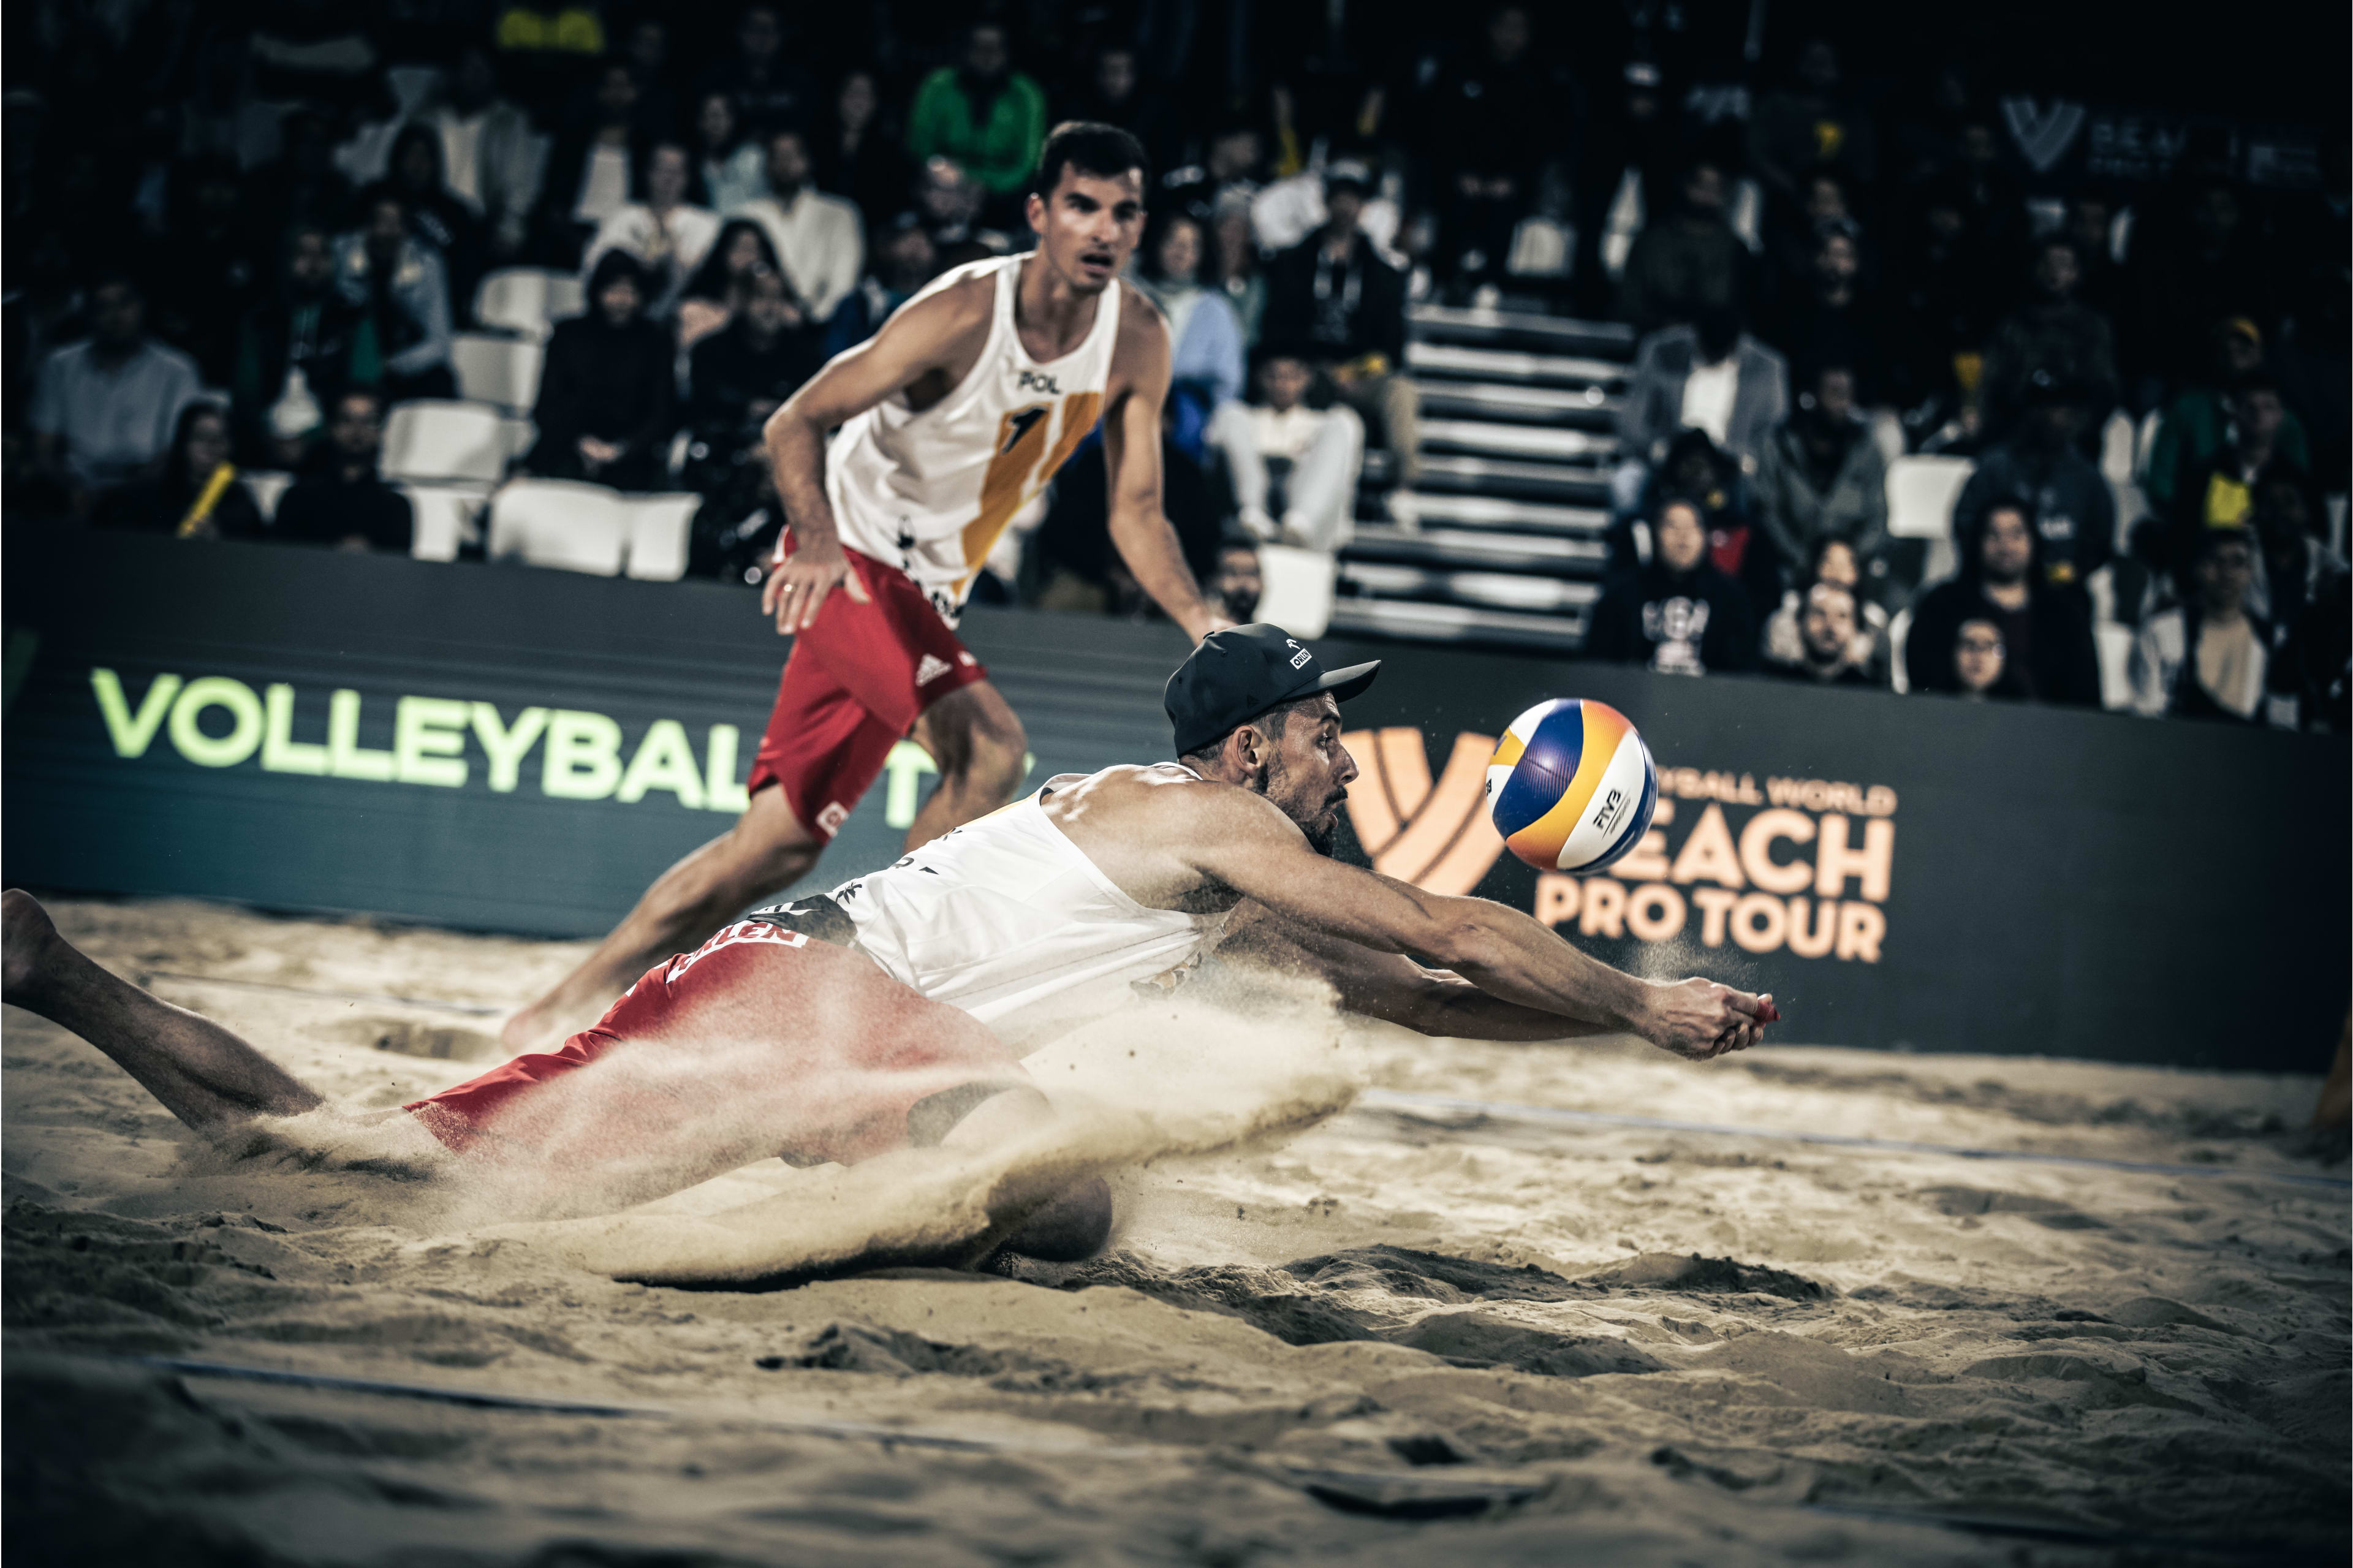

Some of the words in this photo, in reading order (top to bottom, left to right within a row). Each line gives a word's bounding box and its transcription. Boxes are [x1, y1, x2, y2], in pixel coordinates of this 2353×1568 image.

[1018, 371, 1061, 395] POL
[1003, 405, 1050, 455] 1
[1294, 650, 1310, 666] ORLEN
[91, 668, 752, 815] VOLLEYBAL
[1593, 789, 1621, 829] FIVB
[1767, 776, 1897, 817] WORLD
[1607, 798, 1895, 903] EACH
[1534, 874, 1687, 942] PRO
[1692, 887, 1887, 964] TOUR
